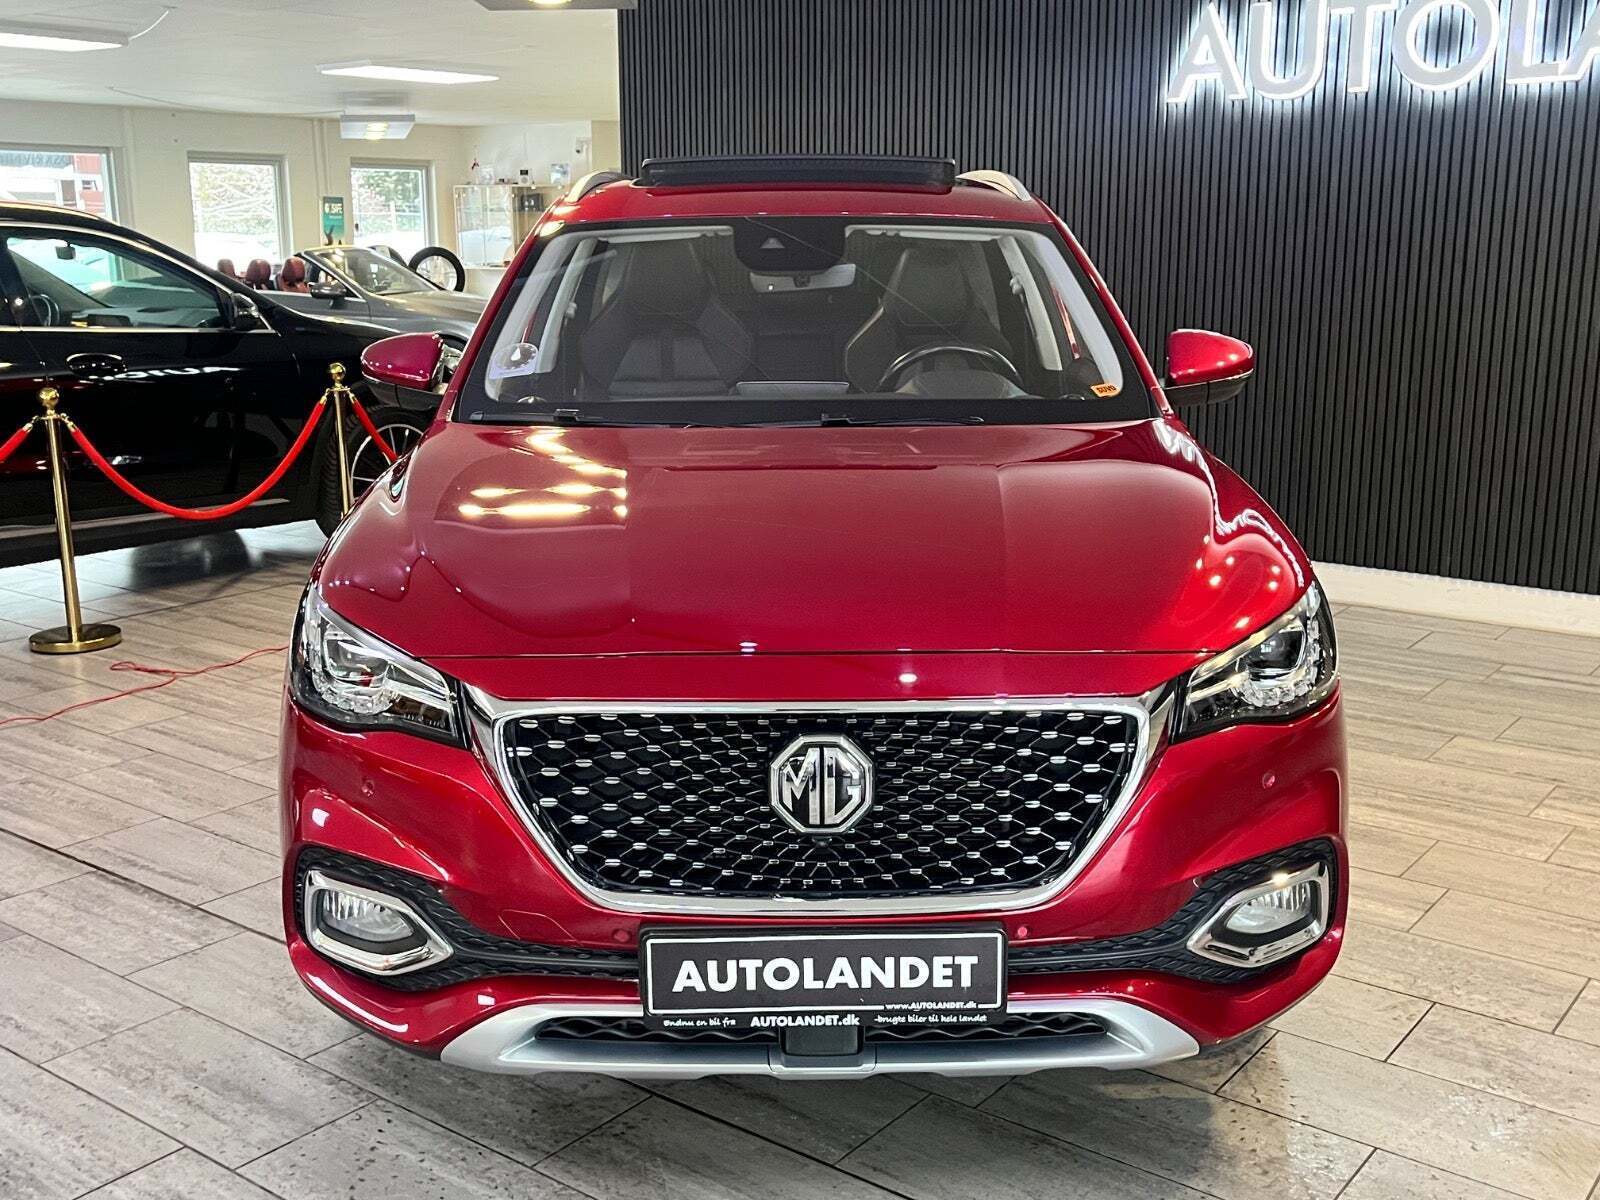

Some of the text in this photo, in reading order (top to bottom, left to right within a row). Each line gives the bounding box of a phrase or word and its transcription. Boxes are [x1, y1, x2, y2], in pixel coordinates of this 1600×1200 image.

[1166, 0, 1600, 102] AUTOL
[780, 745, 864, 827] MG
[671, 955, 979, 993] AUTOLANDET
[708, 1016, 721, 1026] bil
[722, 1016, 736, 1028] fra
[750, 1013, 860, 1027] AUTOLANDET.dk
[907, 1013, 927, 1023] biler
[928, 1013, 940, 1023] til
[958, 1013, 987, 1022] landet
[885, 1000, 977, 1010] www.AUTOLANDET.dk
